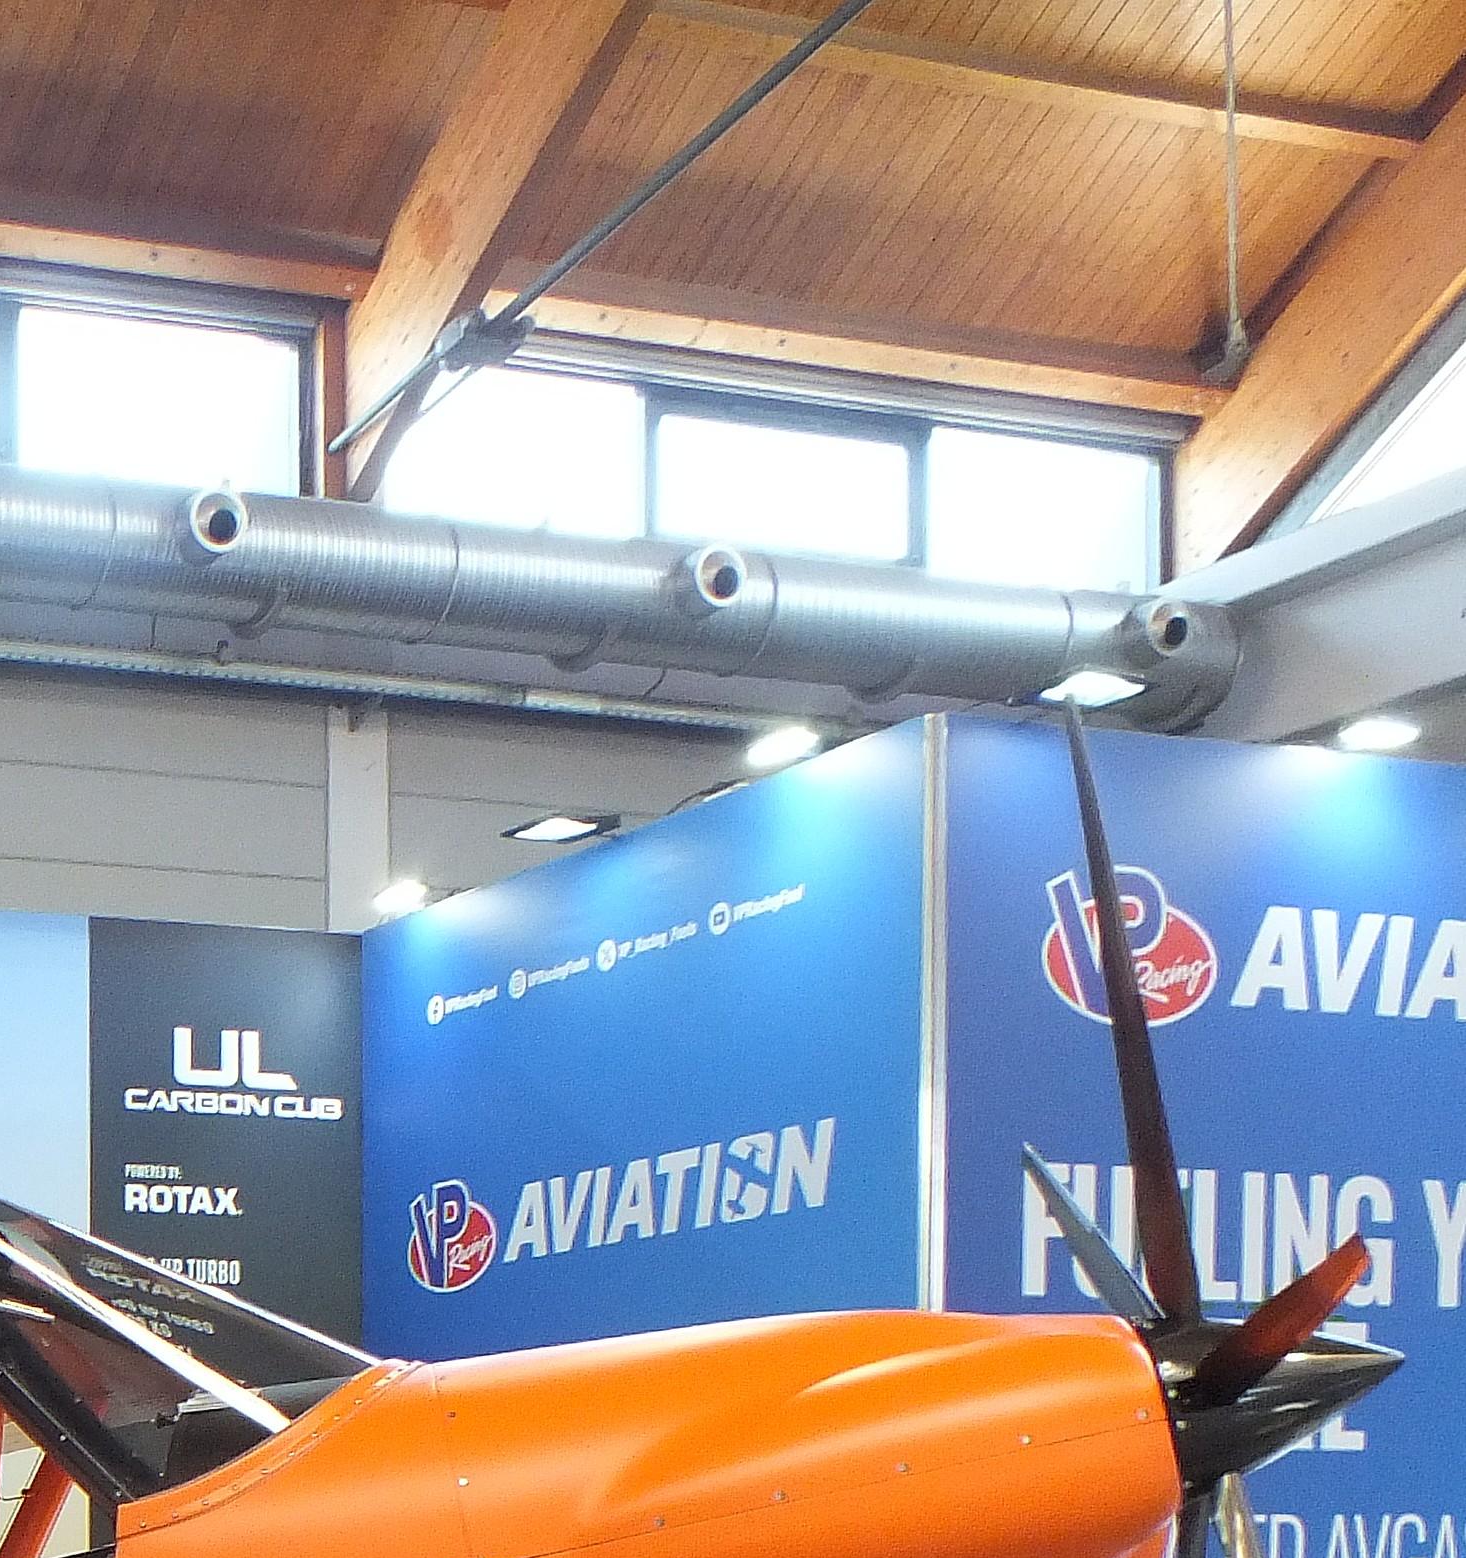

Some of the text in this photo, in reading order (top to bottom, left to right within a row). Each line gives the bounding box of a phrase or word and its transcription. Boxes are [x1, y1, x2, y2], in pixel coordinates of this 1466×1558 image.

[1230, 905, 1466, 1021] AVIA
[173, 1025, 298, 1090] UL
[124, 1088, 344, 1120] CARBON CUB
[124, 1183, 240, 1216] ROTAX
[503, 1116, 836, 1263] AVIATION
[186, 1258, 242, 1286] TURBO
[410, 1178, 469, 1290] VP
[1021, 1163, 1395, 1308] FULING
